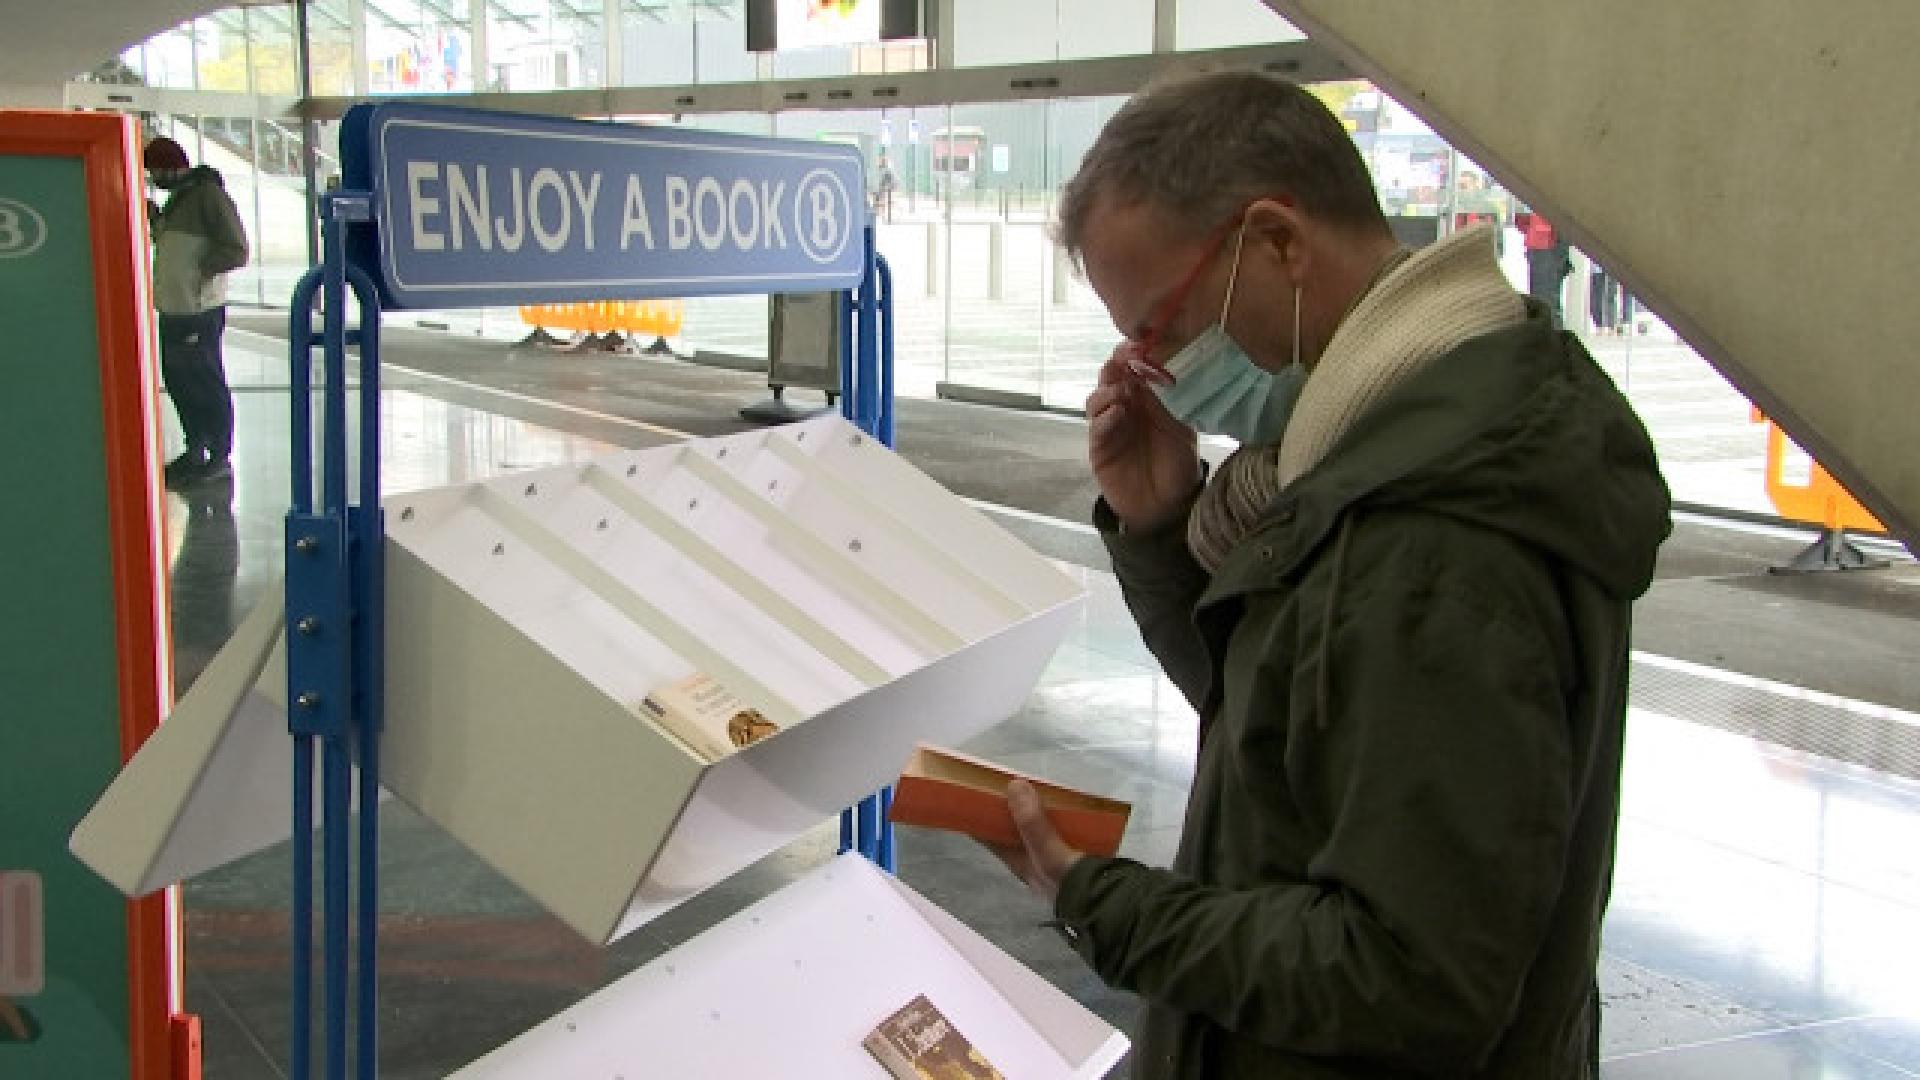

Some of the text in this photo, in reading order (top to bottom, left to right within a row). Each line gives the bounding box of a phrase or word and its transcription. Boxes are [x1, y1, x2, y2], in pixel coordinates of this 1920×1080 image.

[407, 161, 838, 253] ENJOY A BOOK B
